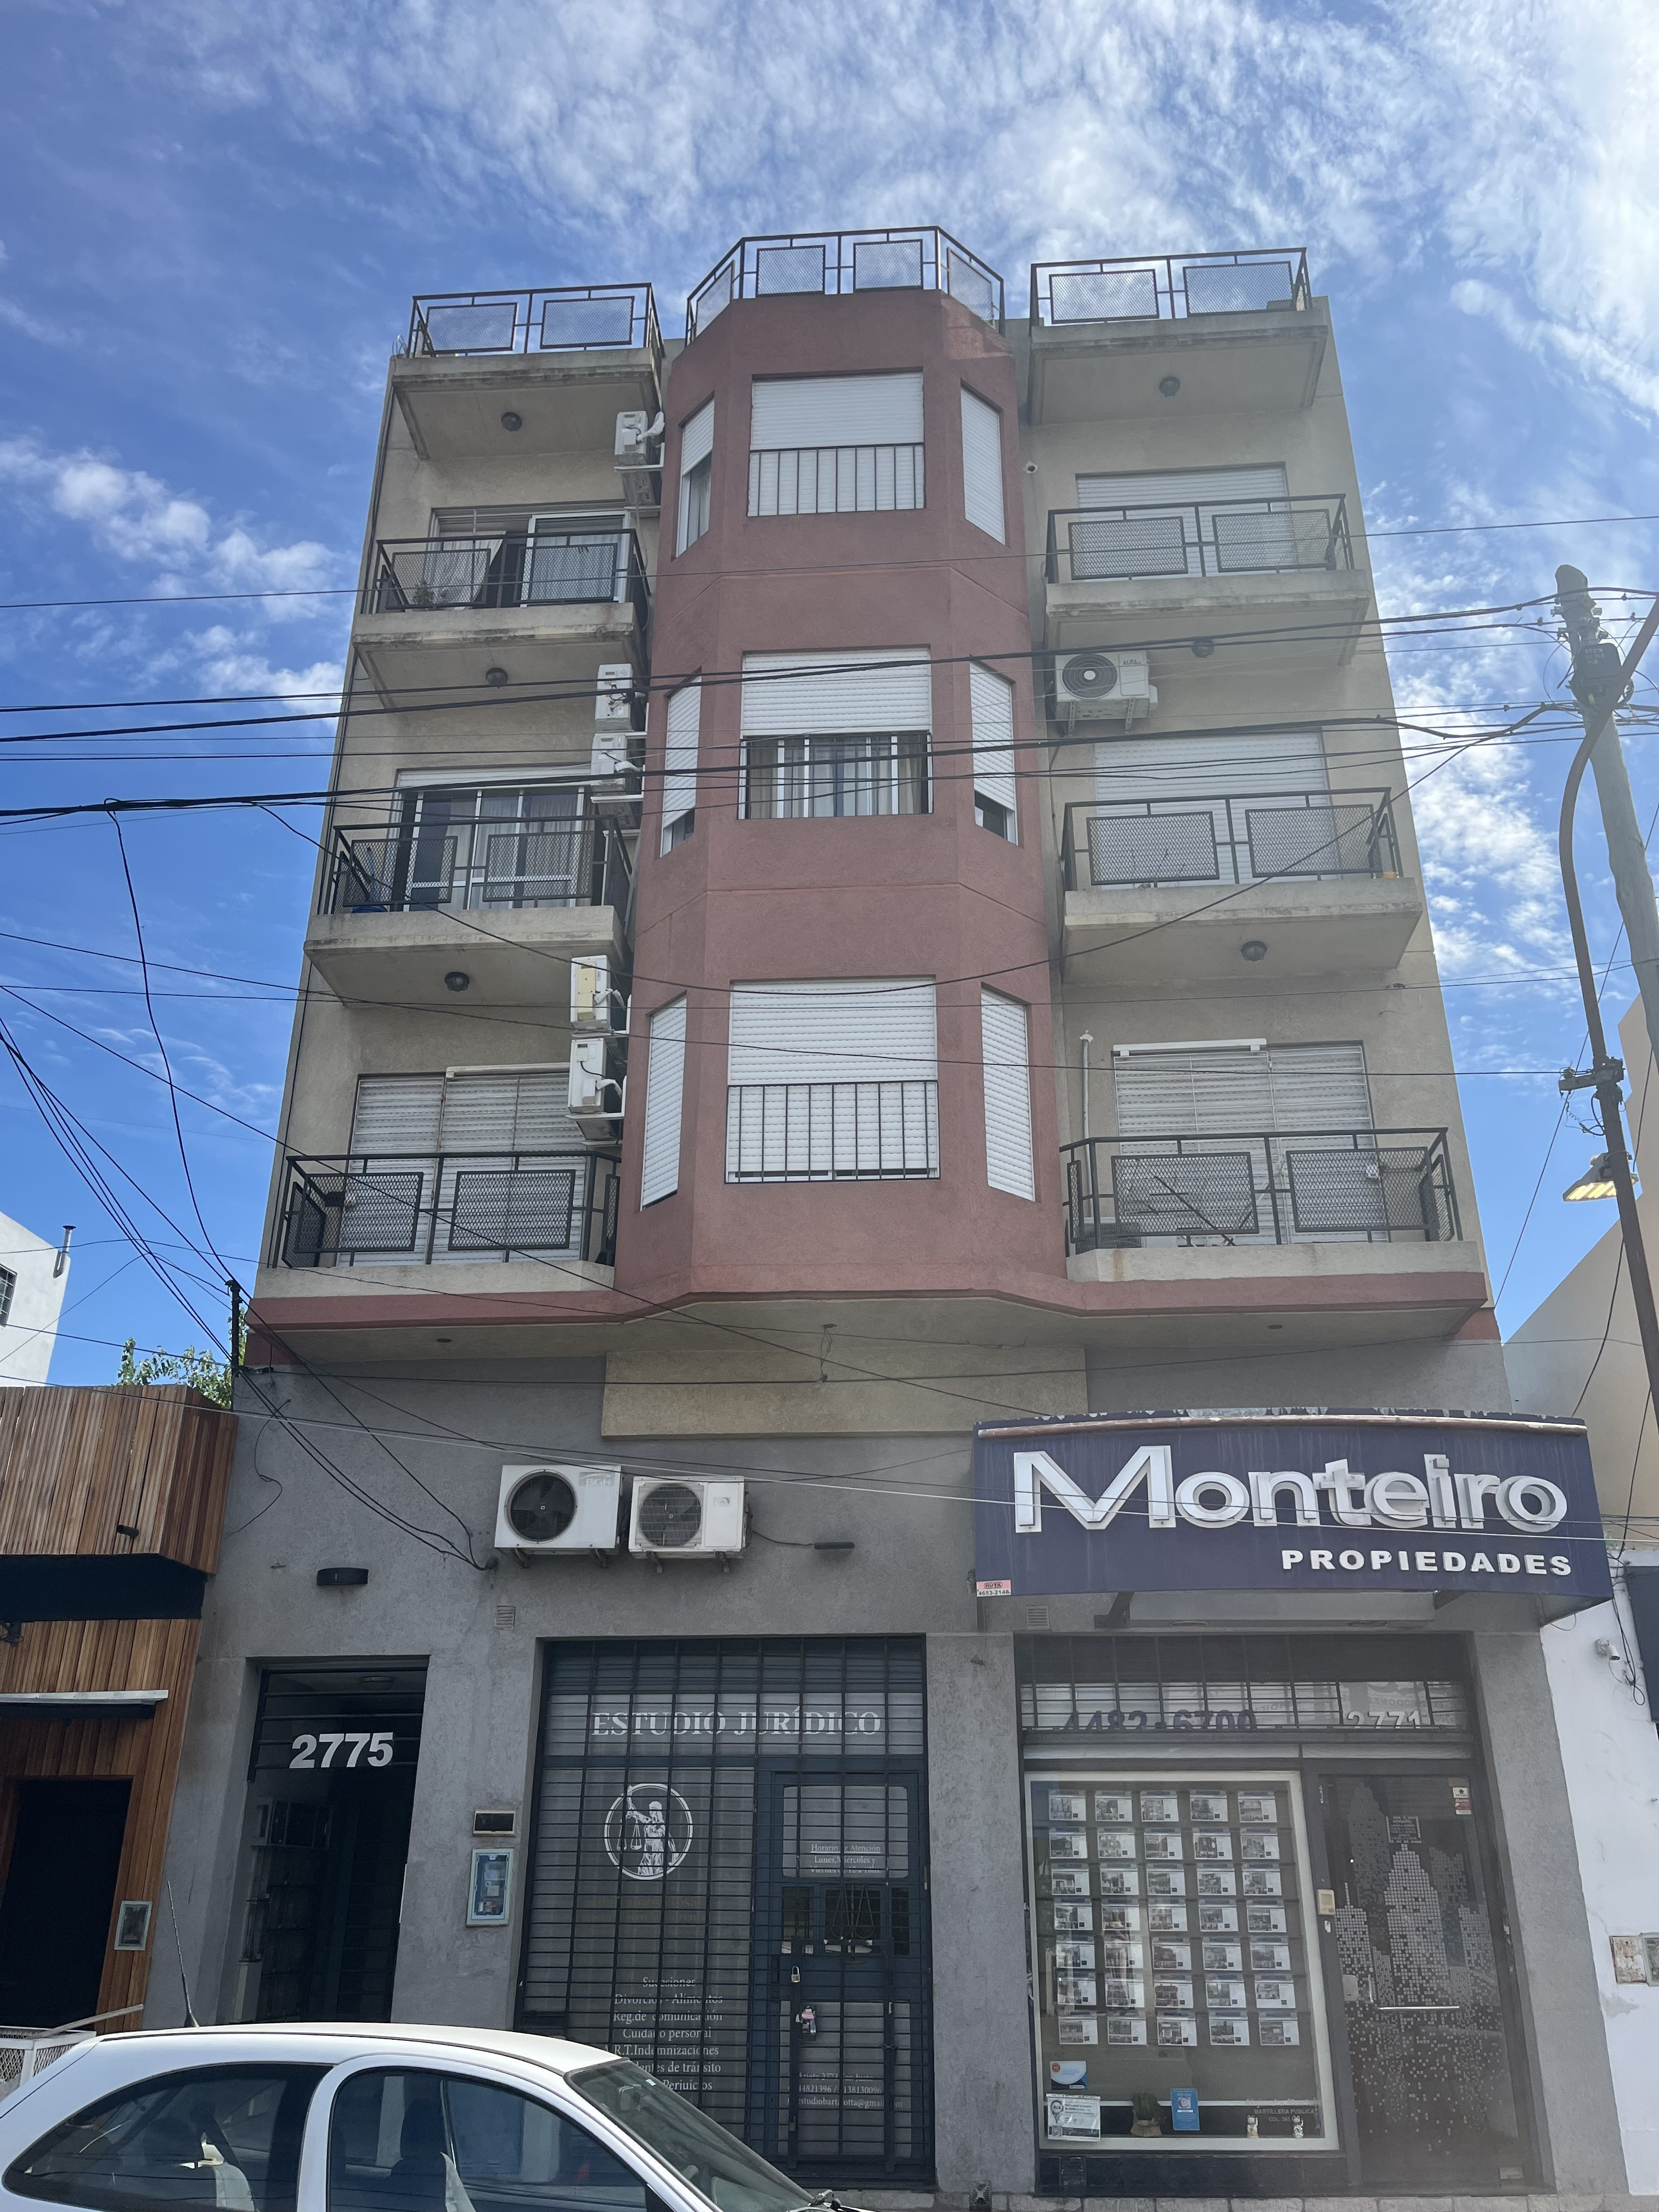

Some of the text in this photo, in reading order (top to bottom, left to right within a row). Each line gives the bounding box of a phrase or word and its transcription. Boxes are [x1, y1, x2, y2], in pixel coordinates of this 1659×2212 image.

[1013, 1445, 1567, 1533] Monteiro
[1282, 1550, 1571, 1576] PROPIEDADES
[591, 1706, 881, 1735] ESTUDIO JURÍDICO
[289, 1731, 394, 1769] 2775
[872, 1858, 876, 1866] y
[668, 2061, 680, 2073] de
